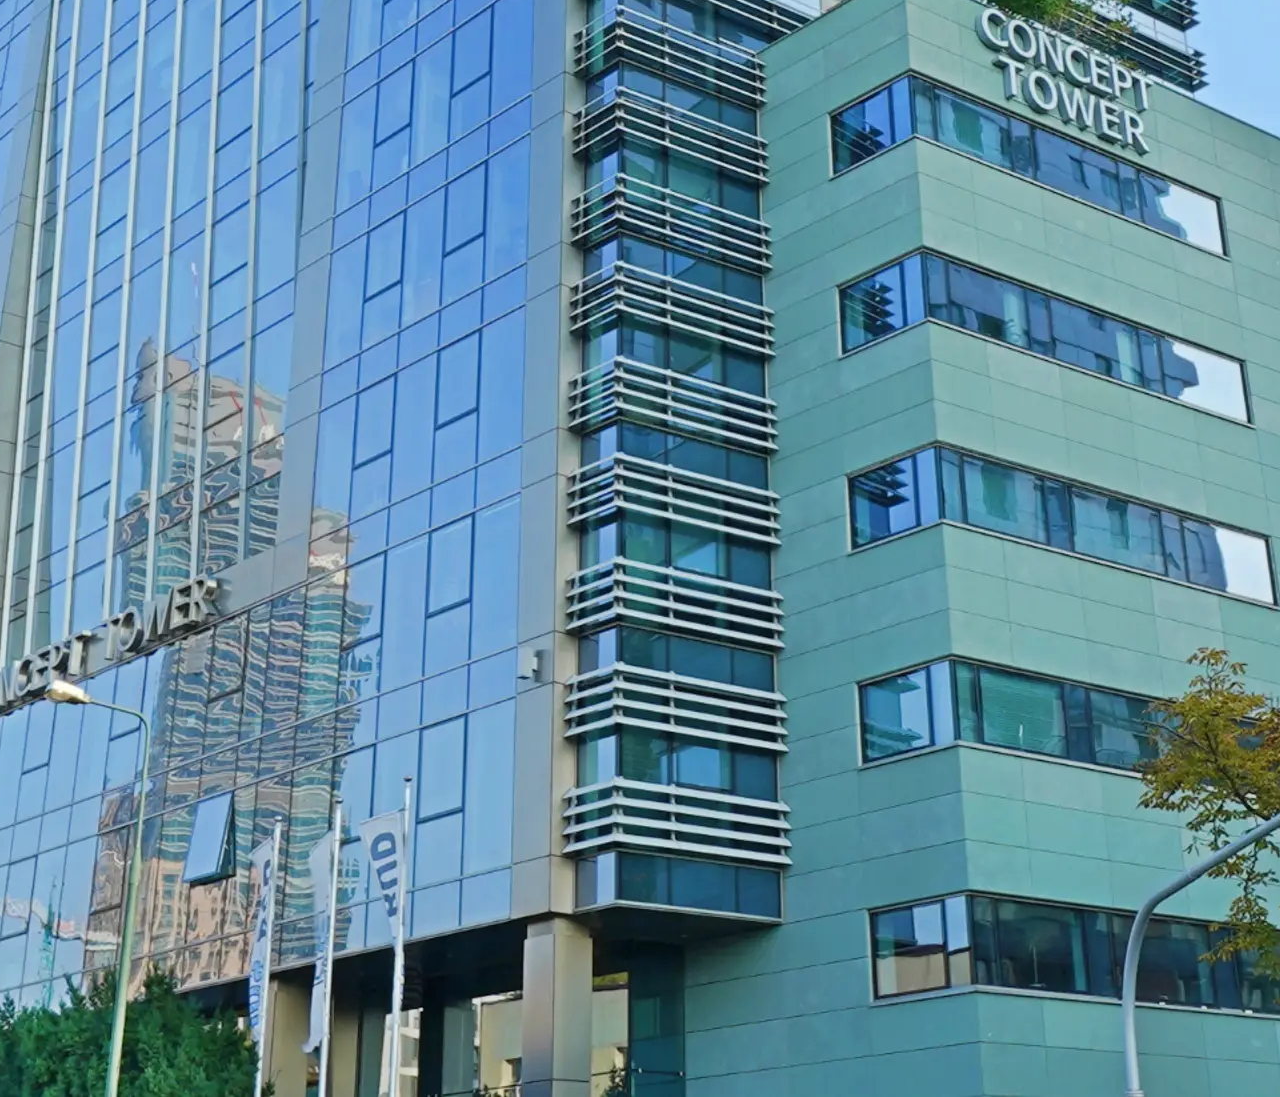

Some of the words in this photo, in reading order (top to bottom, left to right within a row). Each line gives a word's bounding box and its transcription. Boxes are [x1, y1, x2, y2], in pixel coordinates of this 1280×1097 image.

[975, 7, 1153, 113] CONCEPT
[992, 55, 1151, 157] TOWER
[104, 573, 222, 661] TOWER
